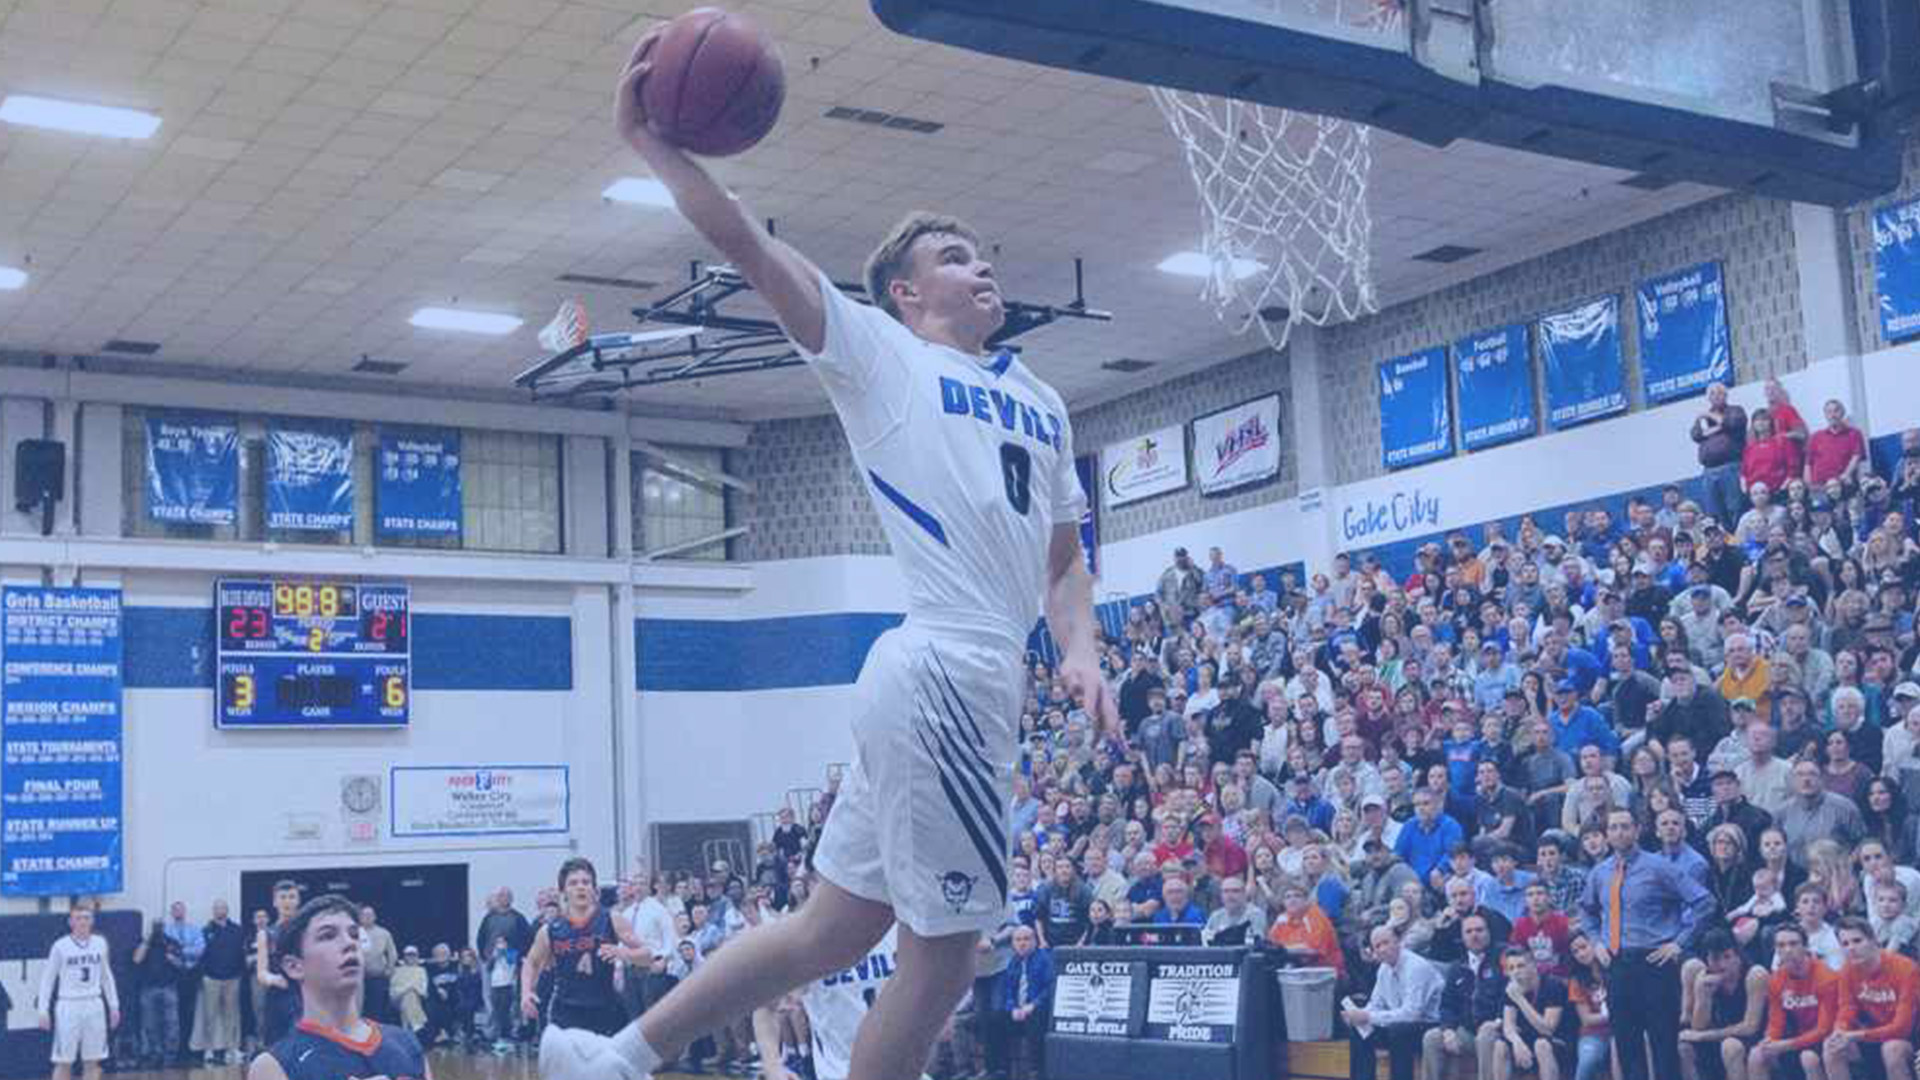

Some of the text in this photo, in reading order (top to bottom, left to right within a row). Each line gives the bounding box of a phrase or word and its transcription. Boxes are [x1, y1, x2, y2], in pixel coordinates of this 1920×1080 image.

[1000, 442, 1031, 515] 0
[271, 512, 350, 526] STATE CHAMPS
[1343, 501, 1388, 541] Gate
[1391, 490, 1439, 531] City
[384, 517, 458, 531] STATE CHAMPS
[43, 592, 118, 609] Basketball
[362, 593, 406, 610] GUEST
[66, 616, 117, 629] CHAMPS
[230, 609, 267, 637] 23
[310, 627, 322, 651] 2
[297, 665, 335, 675] PLAYER
[235, 676, 253, 707] 3
[387, 677, 405, 706] 6
[60, 701, 116, 714] CHAMPS
[7, 741, 40, 754] STATE
[24, 779, 100, 792] FINAL FOUR
[7, 818, 44, 833] STATE
[12, 856, 109, 871] STATE CHAMPS
[577, 952, 593, 975] 4
[1065, 961, 1132, 976] GATE CITY
[1158, 964, 1235, 978] TRADITION
[81, 967, 90, 982] 3
[1055, 1021, 1127, 1035] BLUE DEVILS
[1169, 1026, 1212, 1041] PRIDE
